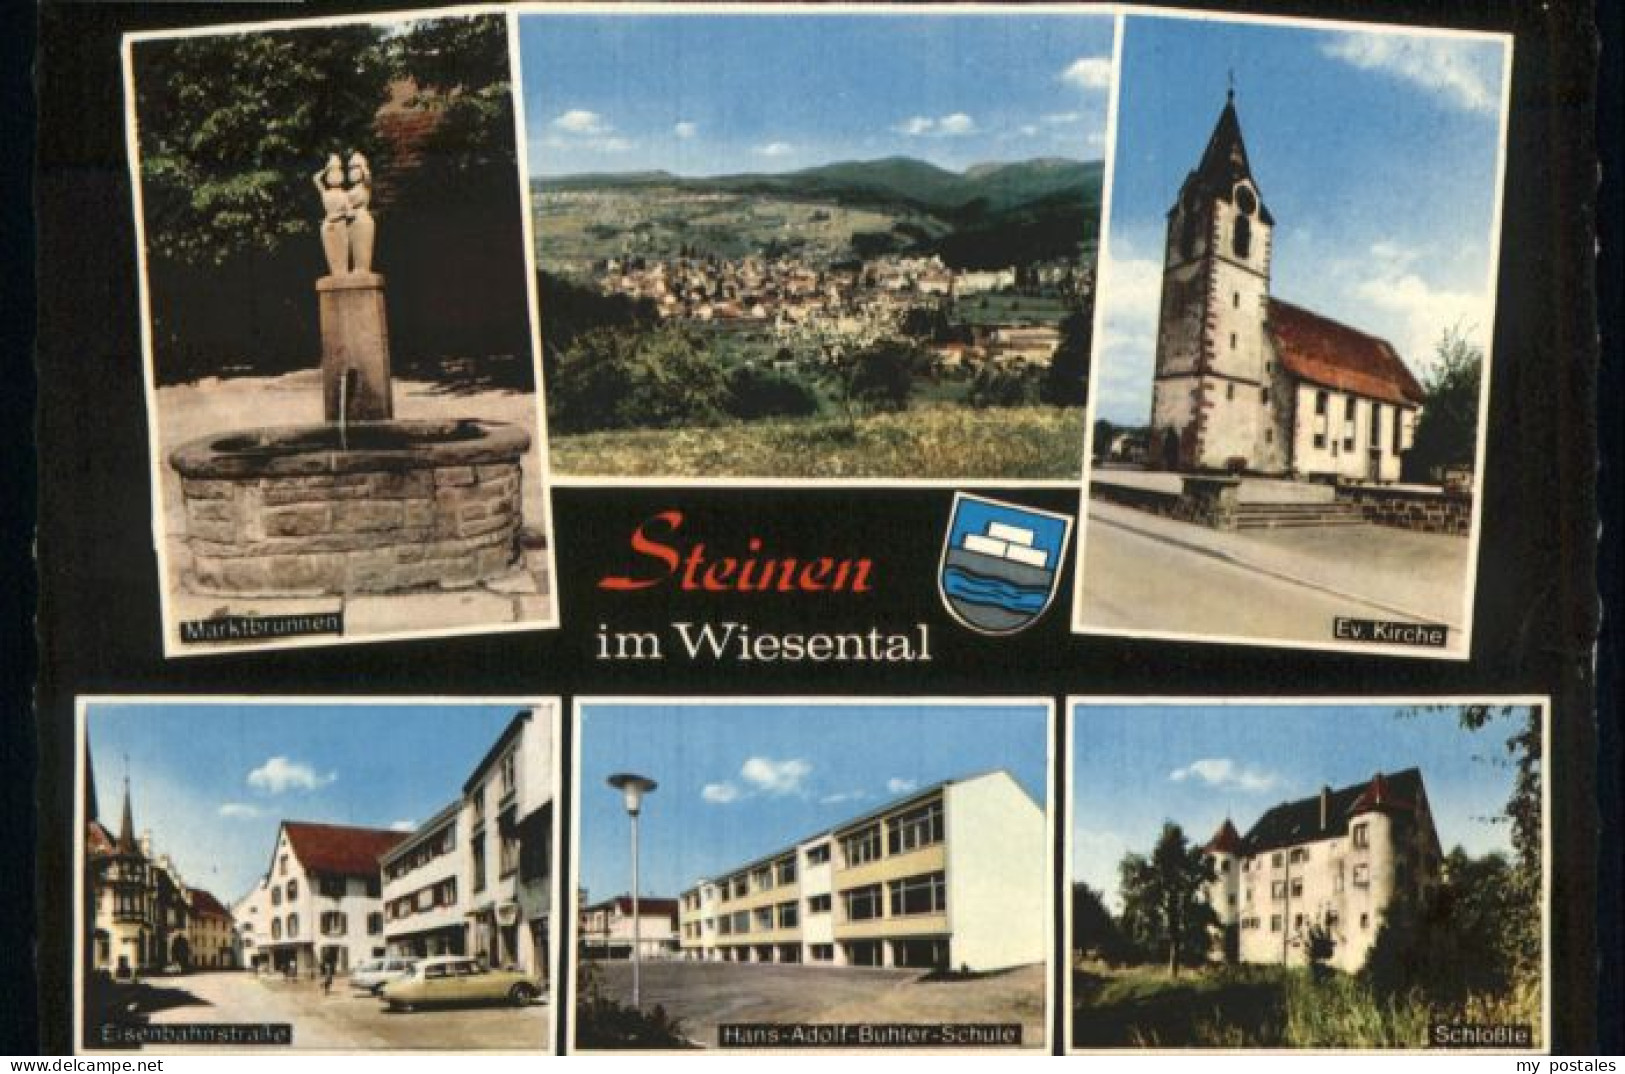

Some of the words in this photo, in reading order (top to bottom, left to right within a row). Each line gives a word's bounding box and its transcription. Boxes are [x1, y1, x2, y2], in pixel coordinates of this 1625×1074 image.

[598, 510, 872, 592] Steinen
[187, 615, 338, 639] Marktbrunnen
[597, 623, 662, 660] im
[671, 621, 932, 661] Wiesental
[1373, 621, 1443, 644] Kirche
